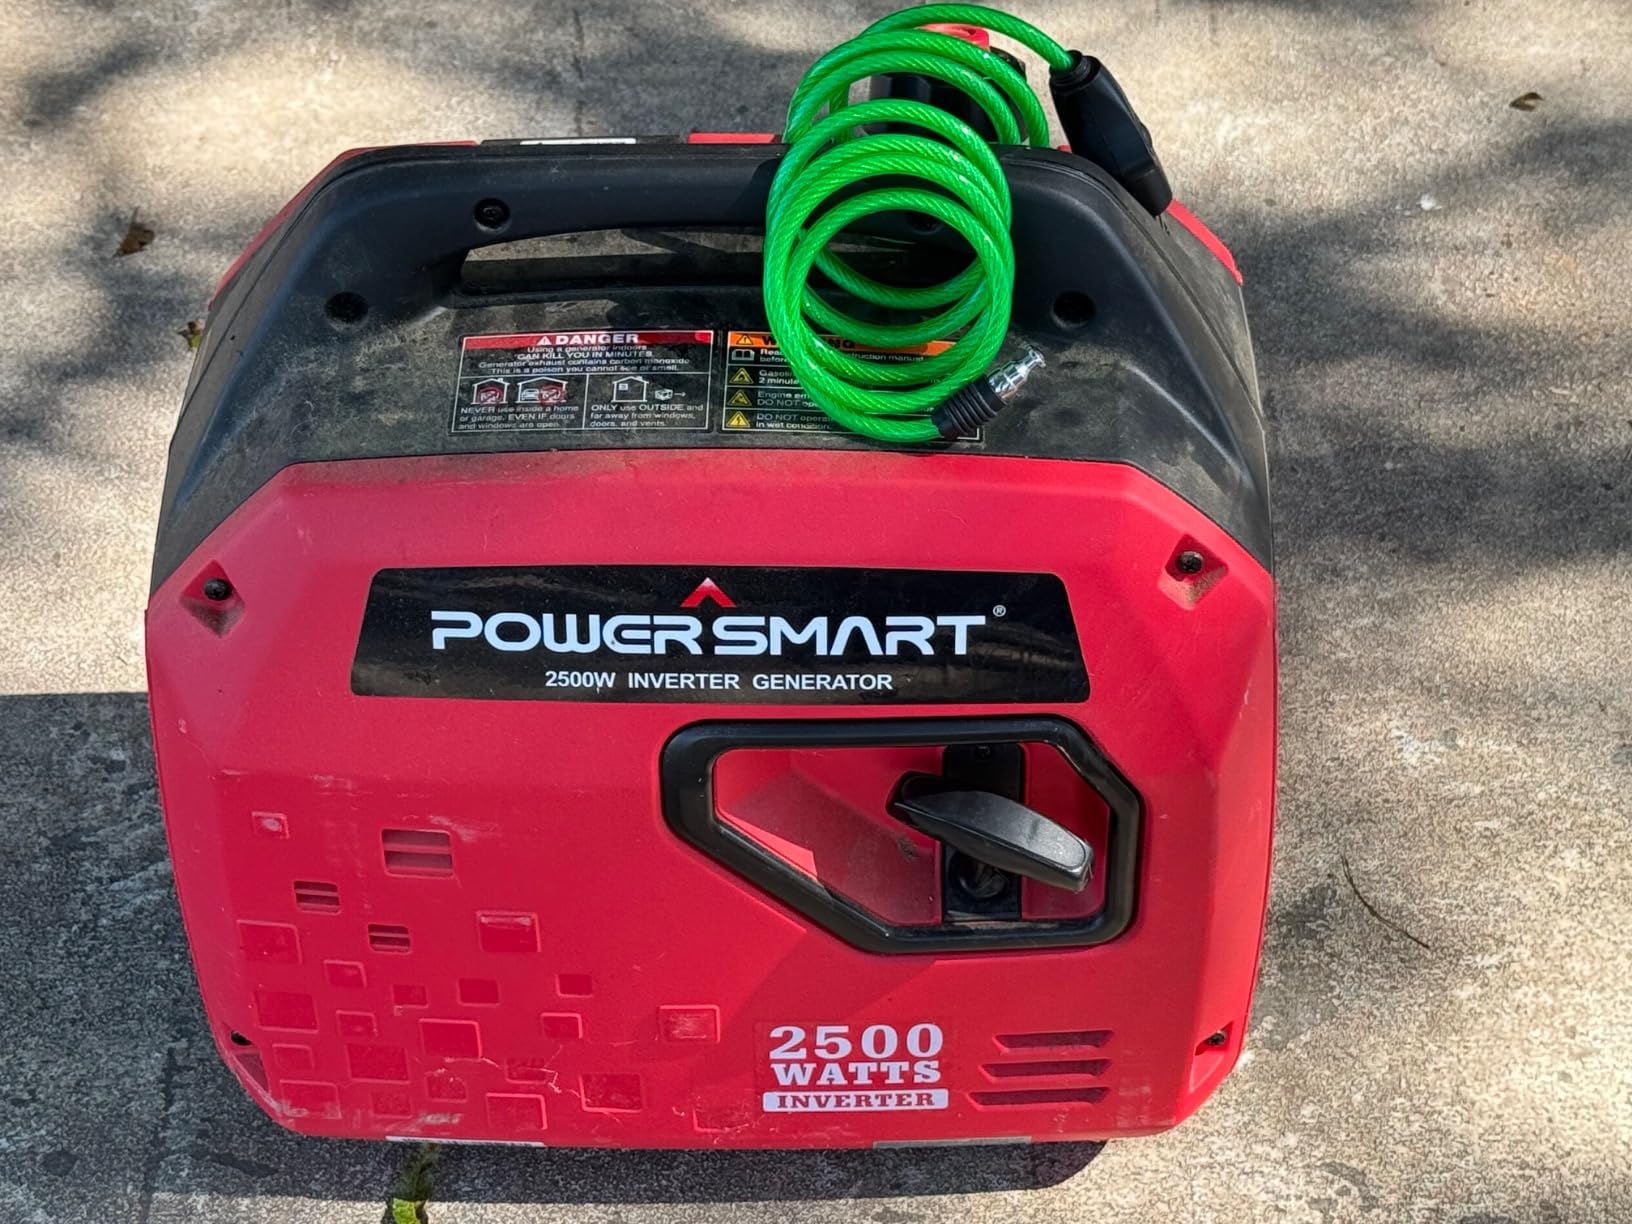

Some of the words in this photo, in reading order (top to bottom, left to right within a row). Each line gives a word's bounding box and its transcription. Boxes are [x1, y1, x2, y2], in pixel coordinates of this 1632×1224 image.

[555, 333, 640, 345] DANGER
[527, 346, 554, 354] Using
[565, 345, 610, 353] generator
[532, 366, 563, 374] poison
[758, 376, 766, 384] 2
[757, 390, 793, 400] Engine
[638, 403, 685, 411] OUTSIDE
[686, 403, 704, 411] and
[756, 398, 774, 406] DO
[776, 399, 800, 407] NOT
[460, 406, 496, 414] NEVER
[553, 404, 579, 412] home
[549, 412, 575, 420] doors
[604, 412, 630, 420] away
[478, 421, 517, 430] windows
[519, 421, 535, 429] are
[544, 670, 616, 688] 2500W
[628, 672, 740, 689] INVERTER
[752, 673, 894, 690] GENERATOR
[768, 1023, 944, 1060] 2500
[770, 1060, 941, 1086] WATTS
[777, 1092, 936, 1109] INVERTER
